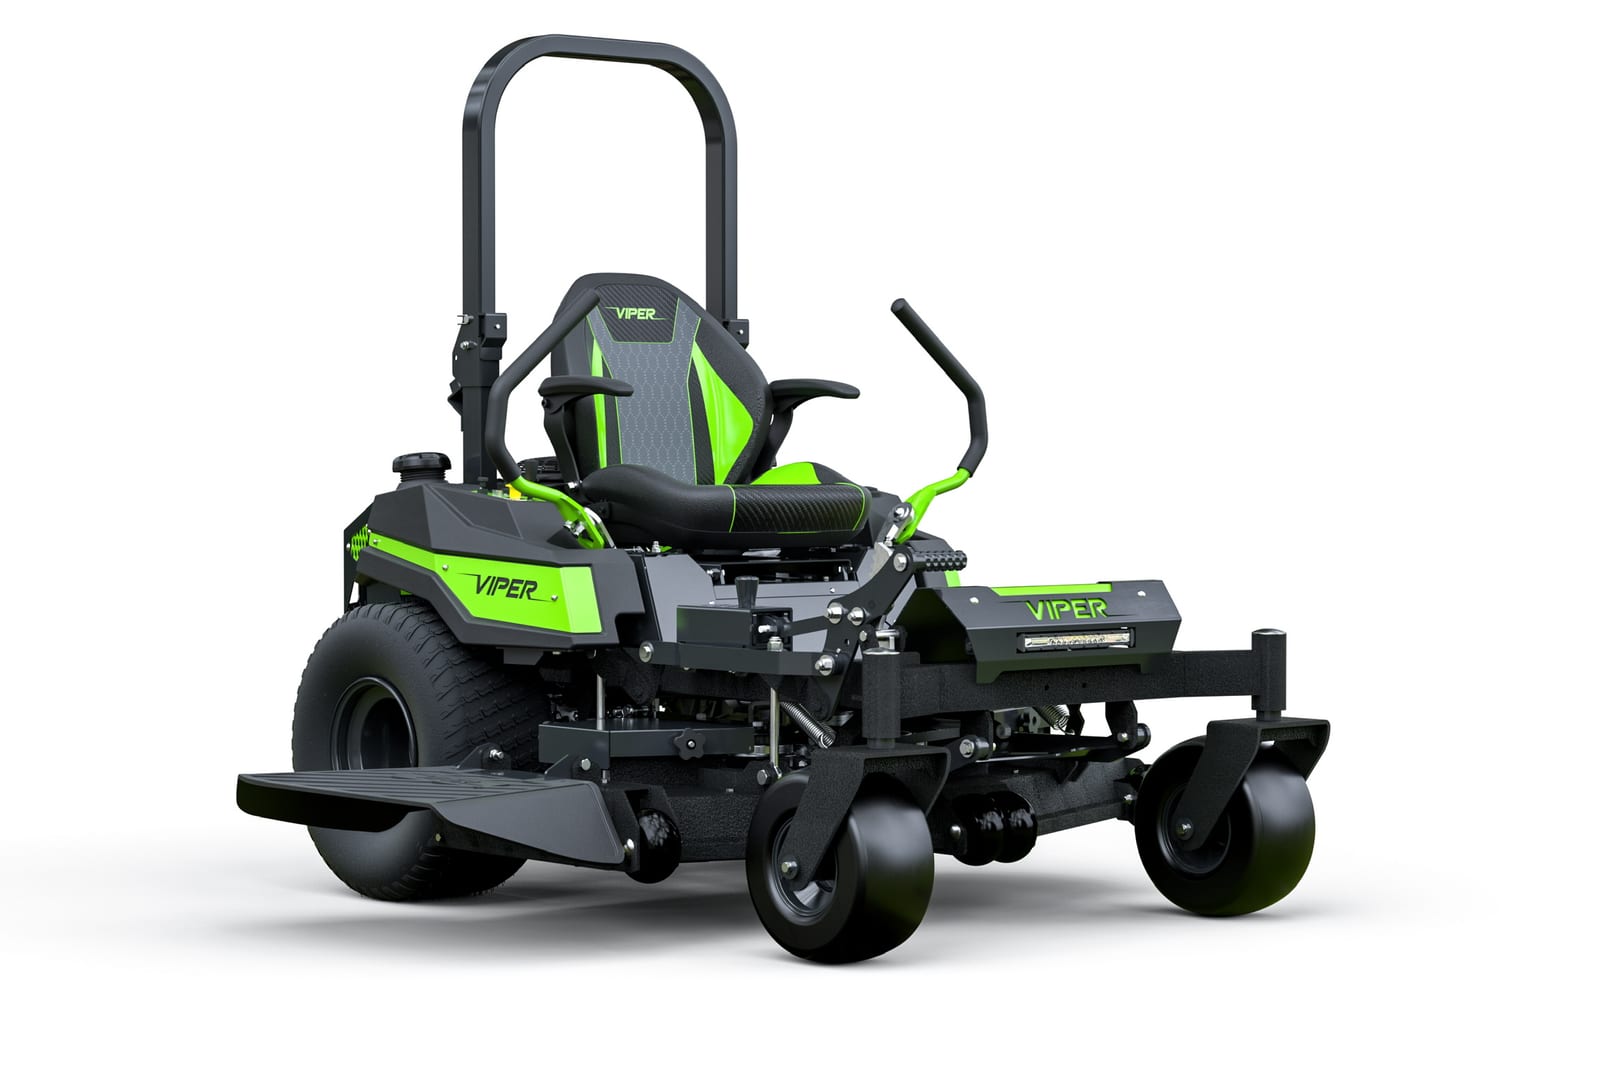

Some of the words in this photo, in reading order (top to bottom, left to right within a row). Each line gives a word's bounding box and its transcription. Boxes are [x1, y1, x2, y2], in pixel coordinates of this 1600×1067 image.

[611, 306, 661, 320] VIPER
[468, 574, 544, 601] VIPER
[1022, 597, 1110, 621] VIPER
